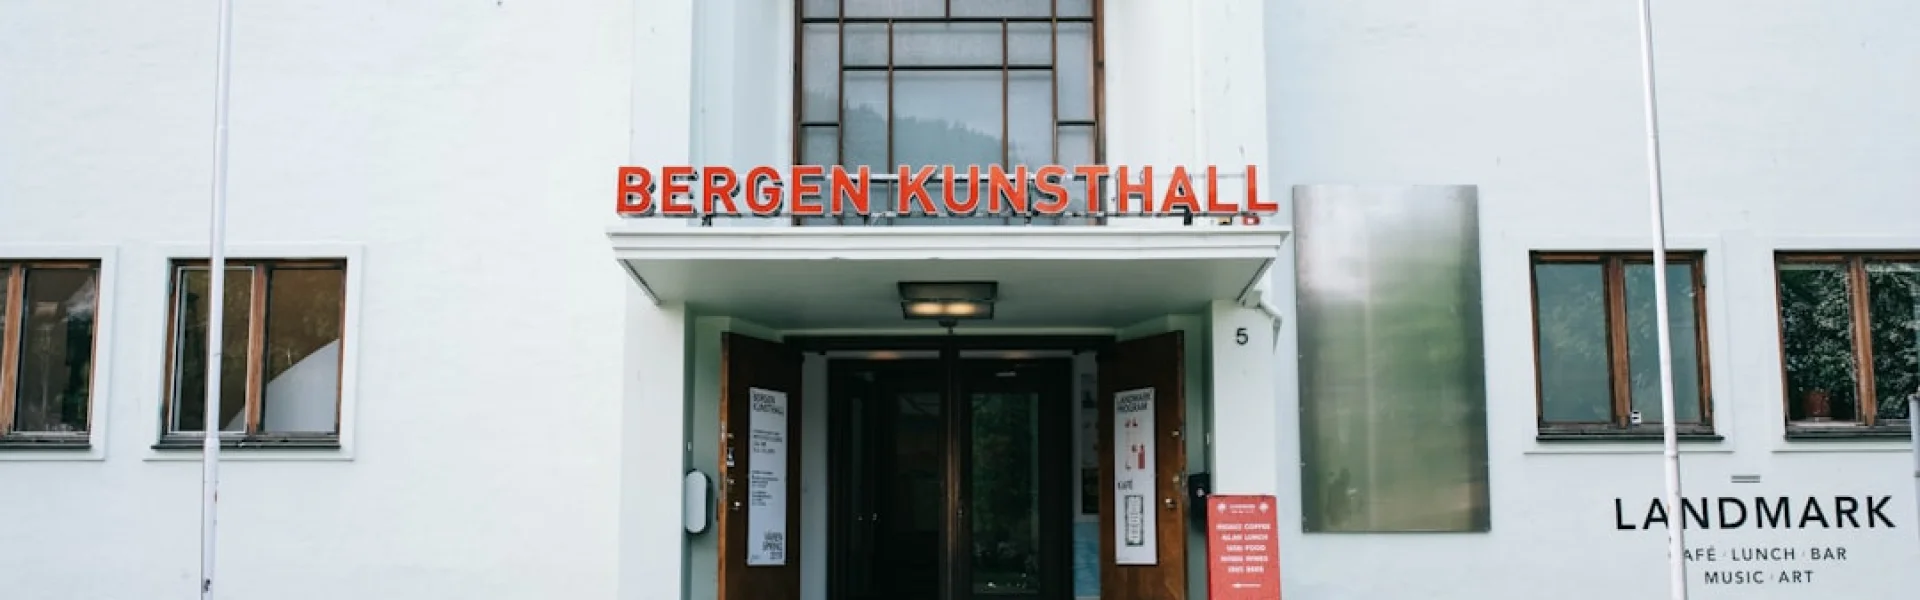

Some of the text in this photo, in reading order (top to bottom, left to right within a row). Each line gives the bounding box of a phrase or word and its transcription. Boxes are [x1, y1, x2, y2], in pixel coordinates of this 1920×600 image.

[616, 165, 1279, 214] BERGEN KUNSTHALL
[1236, 327, 1249, 346] 5
[1614, 495, 1897, 531] LANDMARK
[1670, 546, 1847, 562] AFÉ LUNCH BAR
[1704, 569, 1814, 585] MUSIC ART
